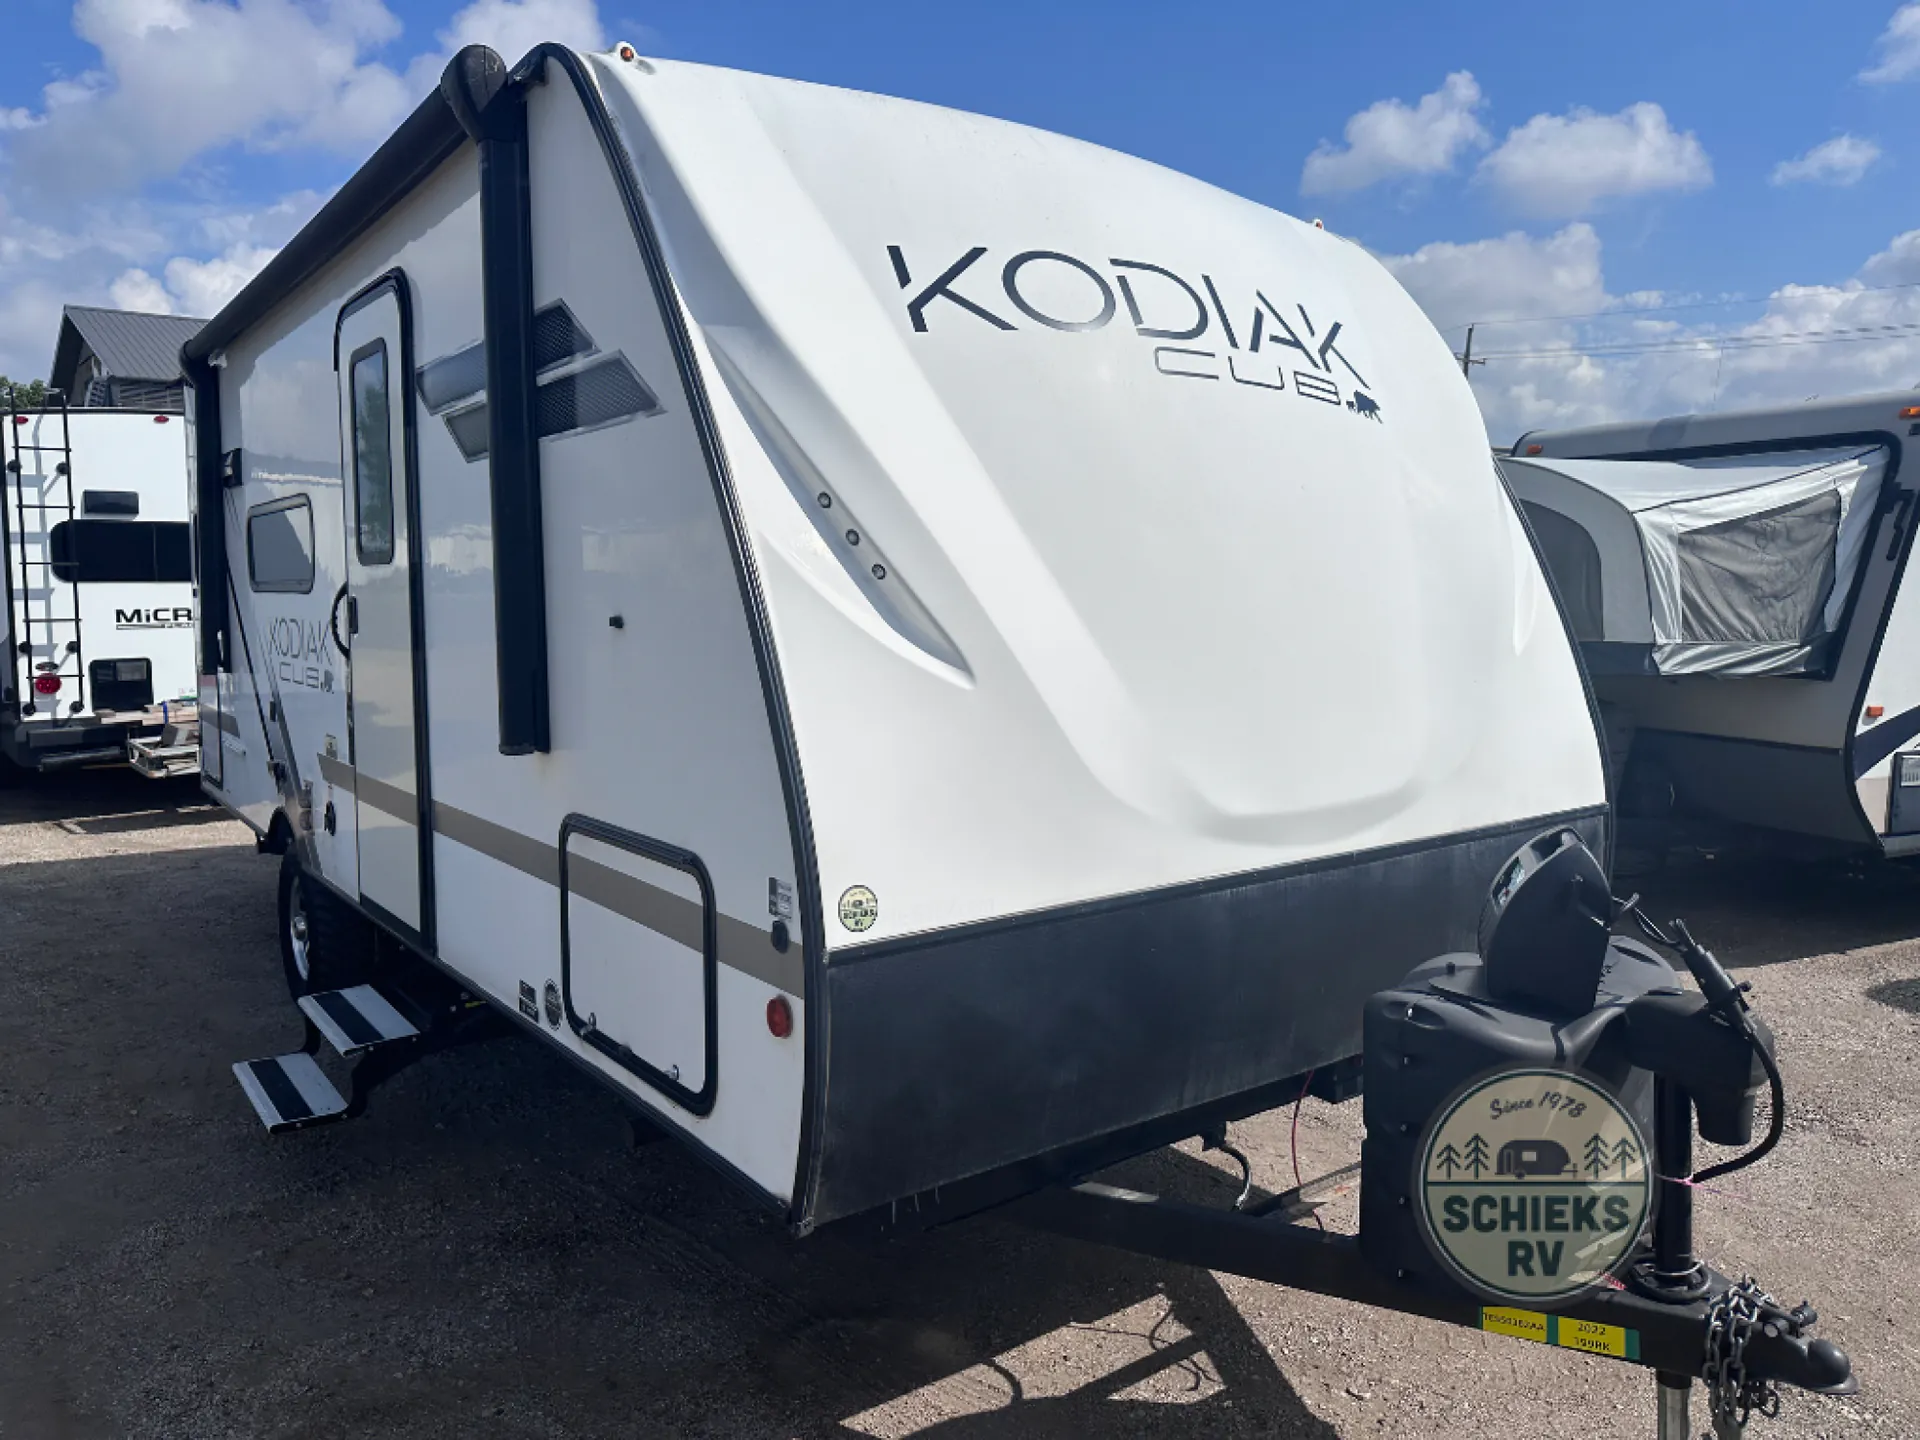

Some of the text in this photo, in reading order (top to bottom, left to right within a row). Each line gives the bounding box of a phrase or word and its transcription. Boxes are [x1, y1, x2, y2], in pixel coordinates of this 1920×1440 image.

[886, 245, 1371, 390] KODIAK
[1154, 346, 1342, 406] CUB
[270, 617, 332, 666] KODIAK
[279, 661, 320, 689] CUB
